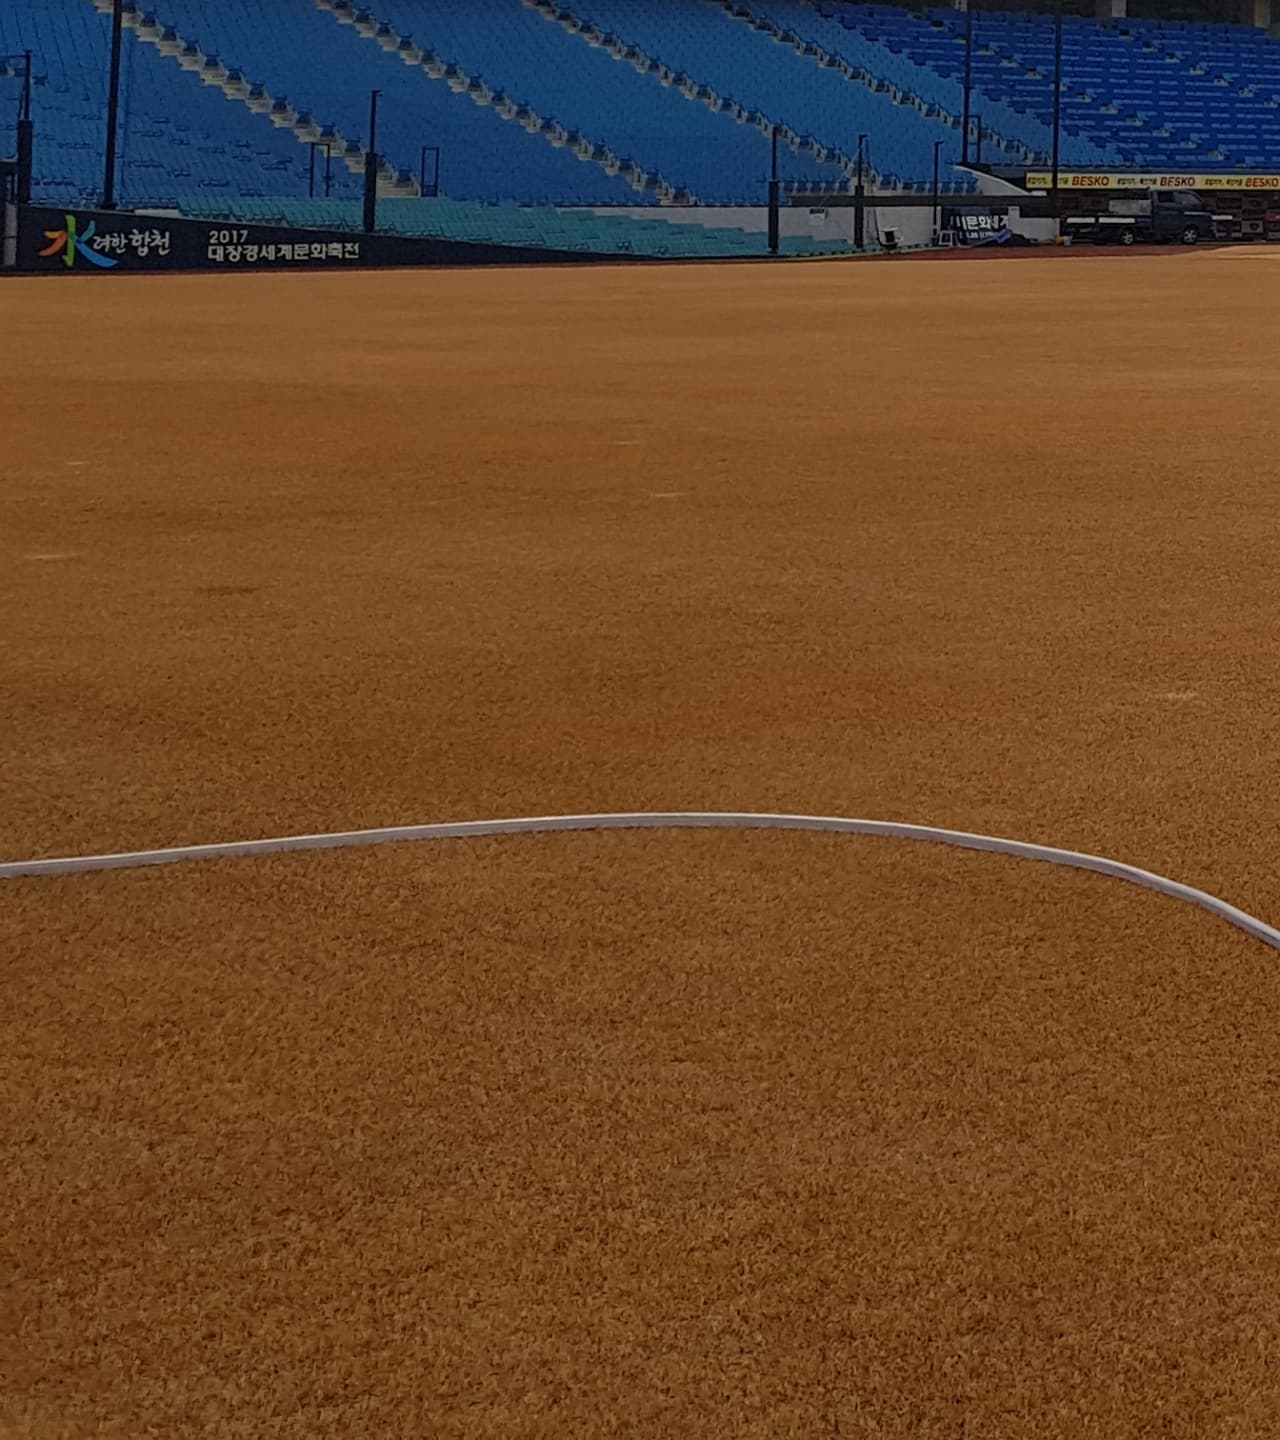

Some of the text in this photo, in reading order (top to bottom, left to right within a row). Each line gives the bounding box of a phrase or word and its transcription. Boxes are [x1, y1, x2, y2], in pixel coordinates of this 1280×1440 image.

[129, 228, 171, 257] 합천
[208, 230, 250, 244] 2017
[207, 241, 360, 263] 대장경세계문화축전
